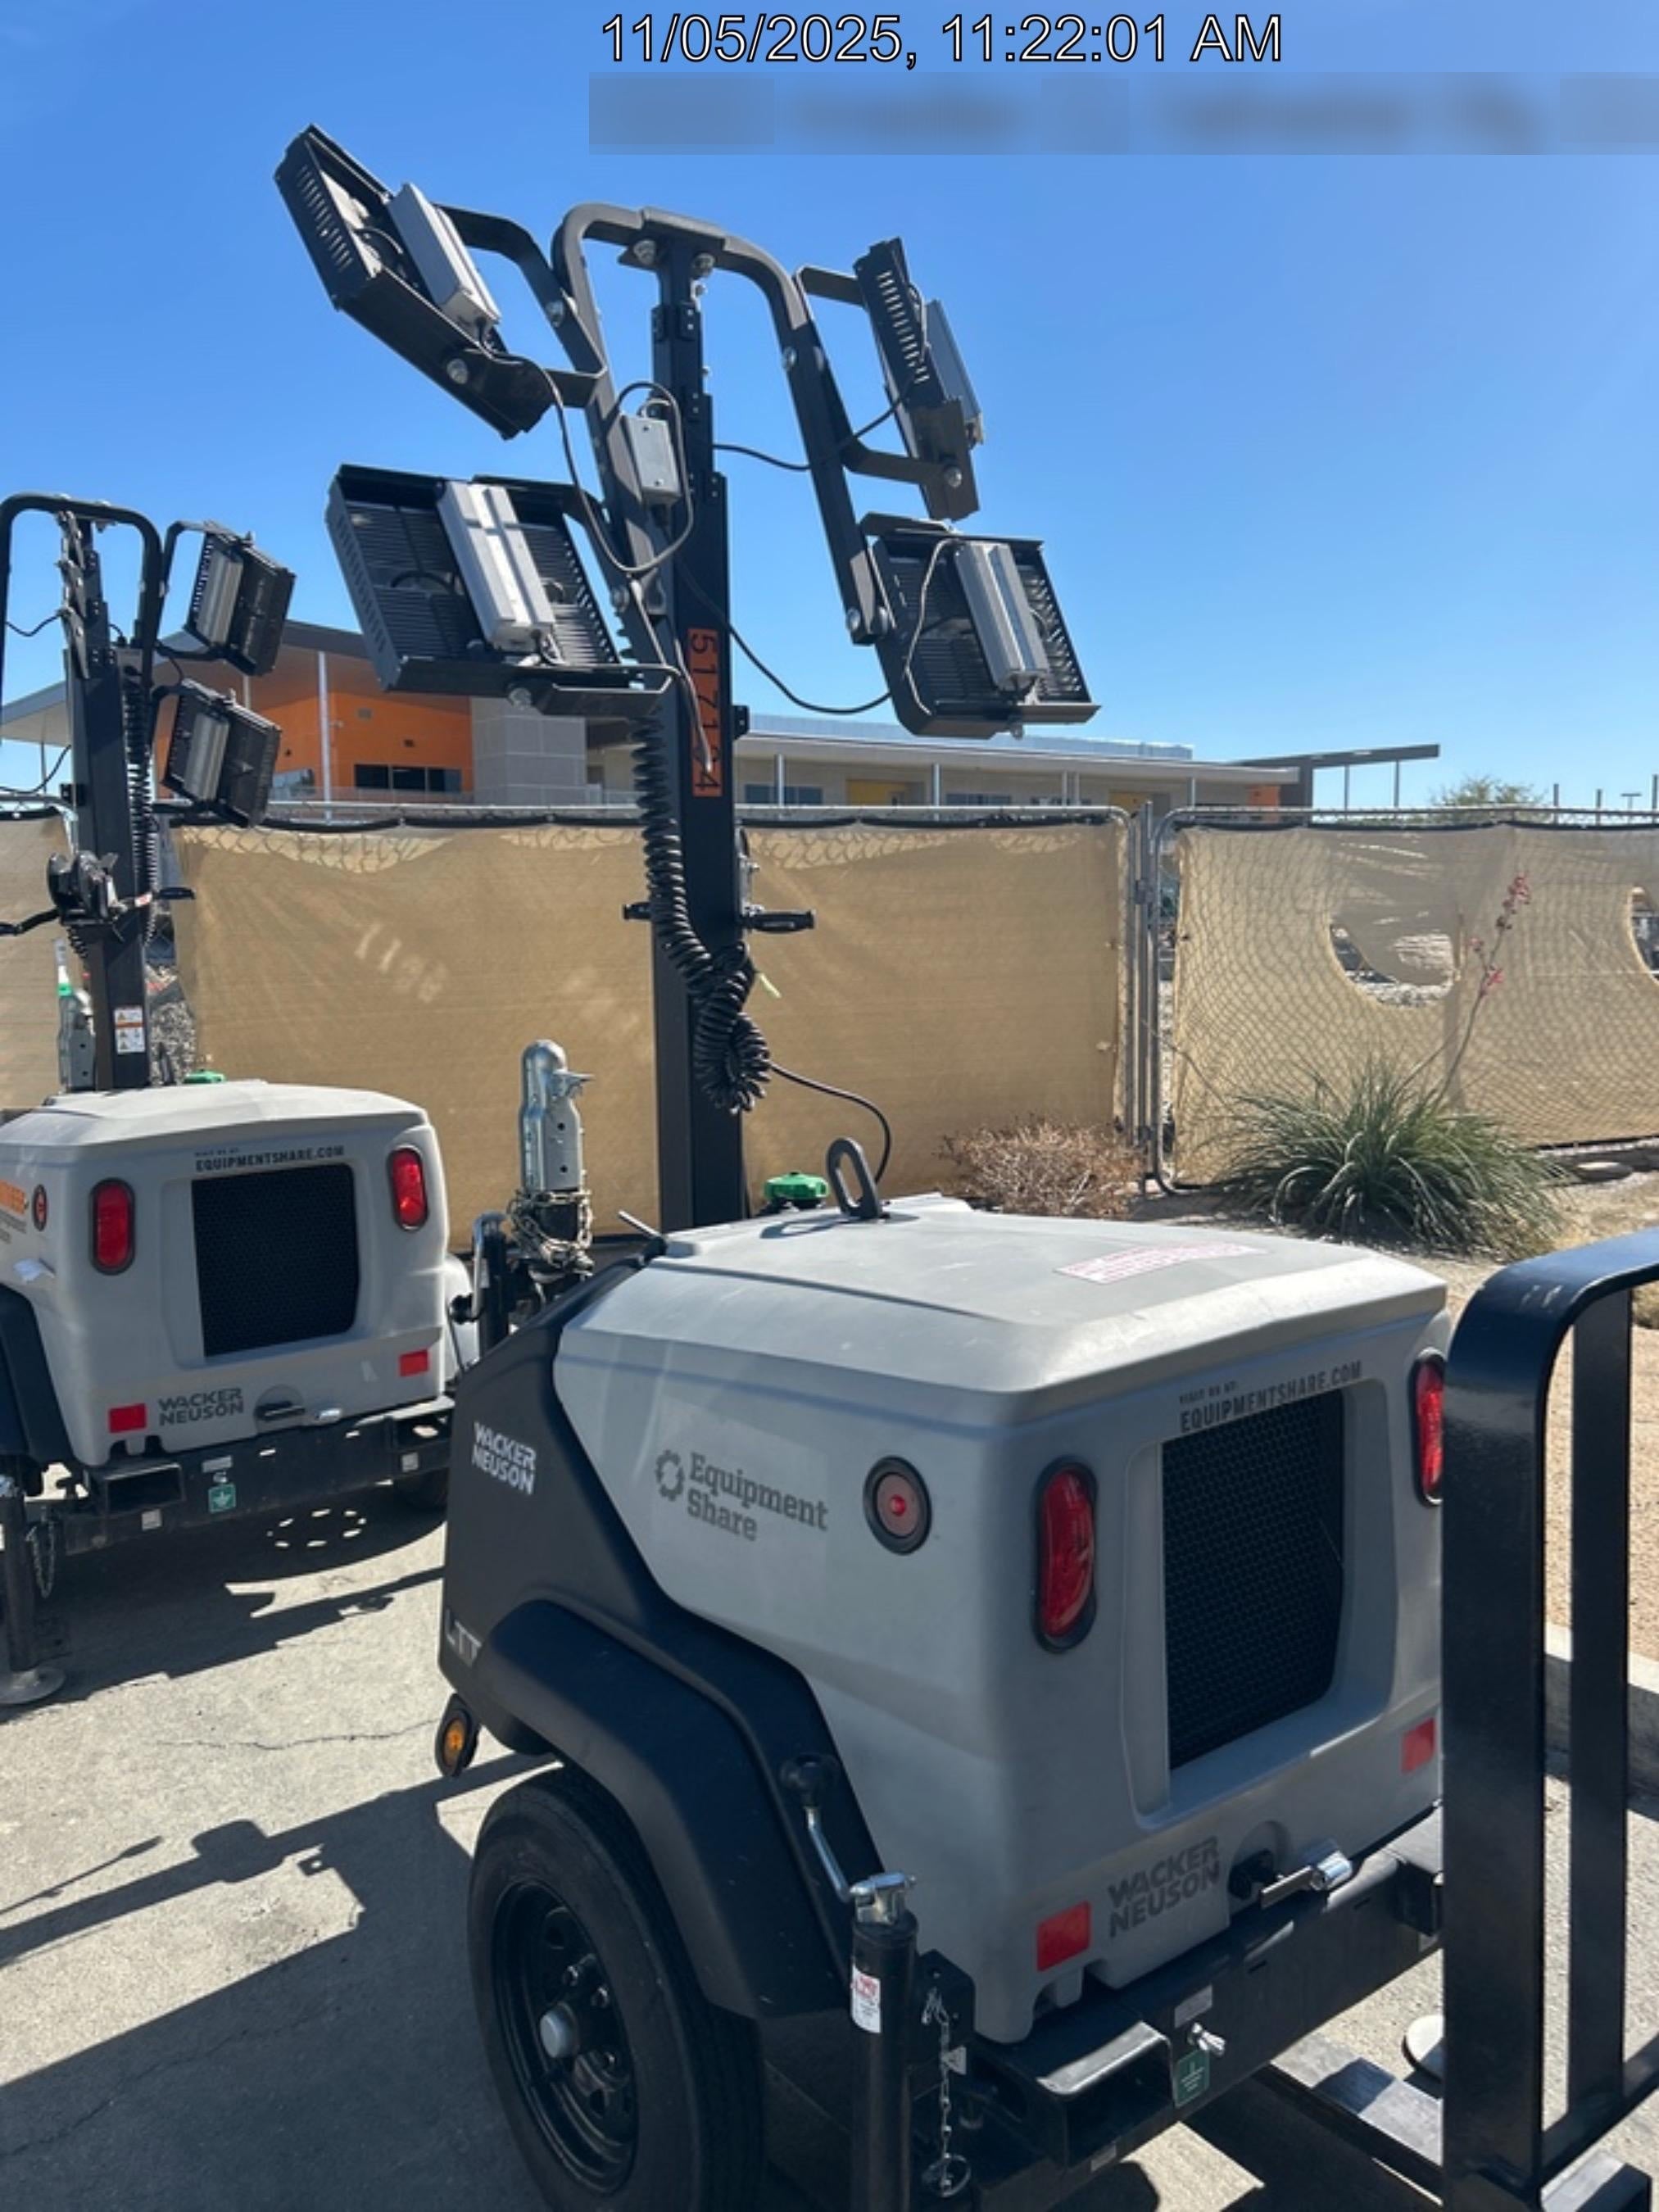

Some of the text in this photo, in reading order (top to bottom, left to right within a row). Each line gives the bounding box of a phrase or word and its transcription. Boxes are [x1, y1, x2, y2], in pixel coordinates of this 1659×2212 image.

[195, 1145, 344, 1172] EQUIPMENTSHARE.COM
[158, 1388, 243, 1412] WACKER
[159, 1402, 243, 1426] NEUSON
[1180, 1360, 1362, 1433] EQUIPMENTSHARE.COM
[472, 1443, 534, 1494] NEUSON
[474, 1421, 536, 1471] WACKER
[687, 1488, 758, 1542] Share
[690, 1452, 829, 1532] Equipment
[1107, 1835, 1219, 1909] WACKER
[1109, 1860, 1220, 1938] NEUSON
